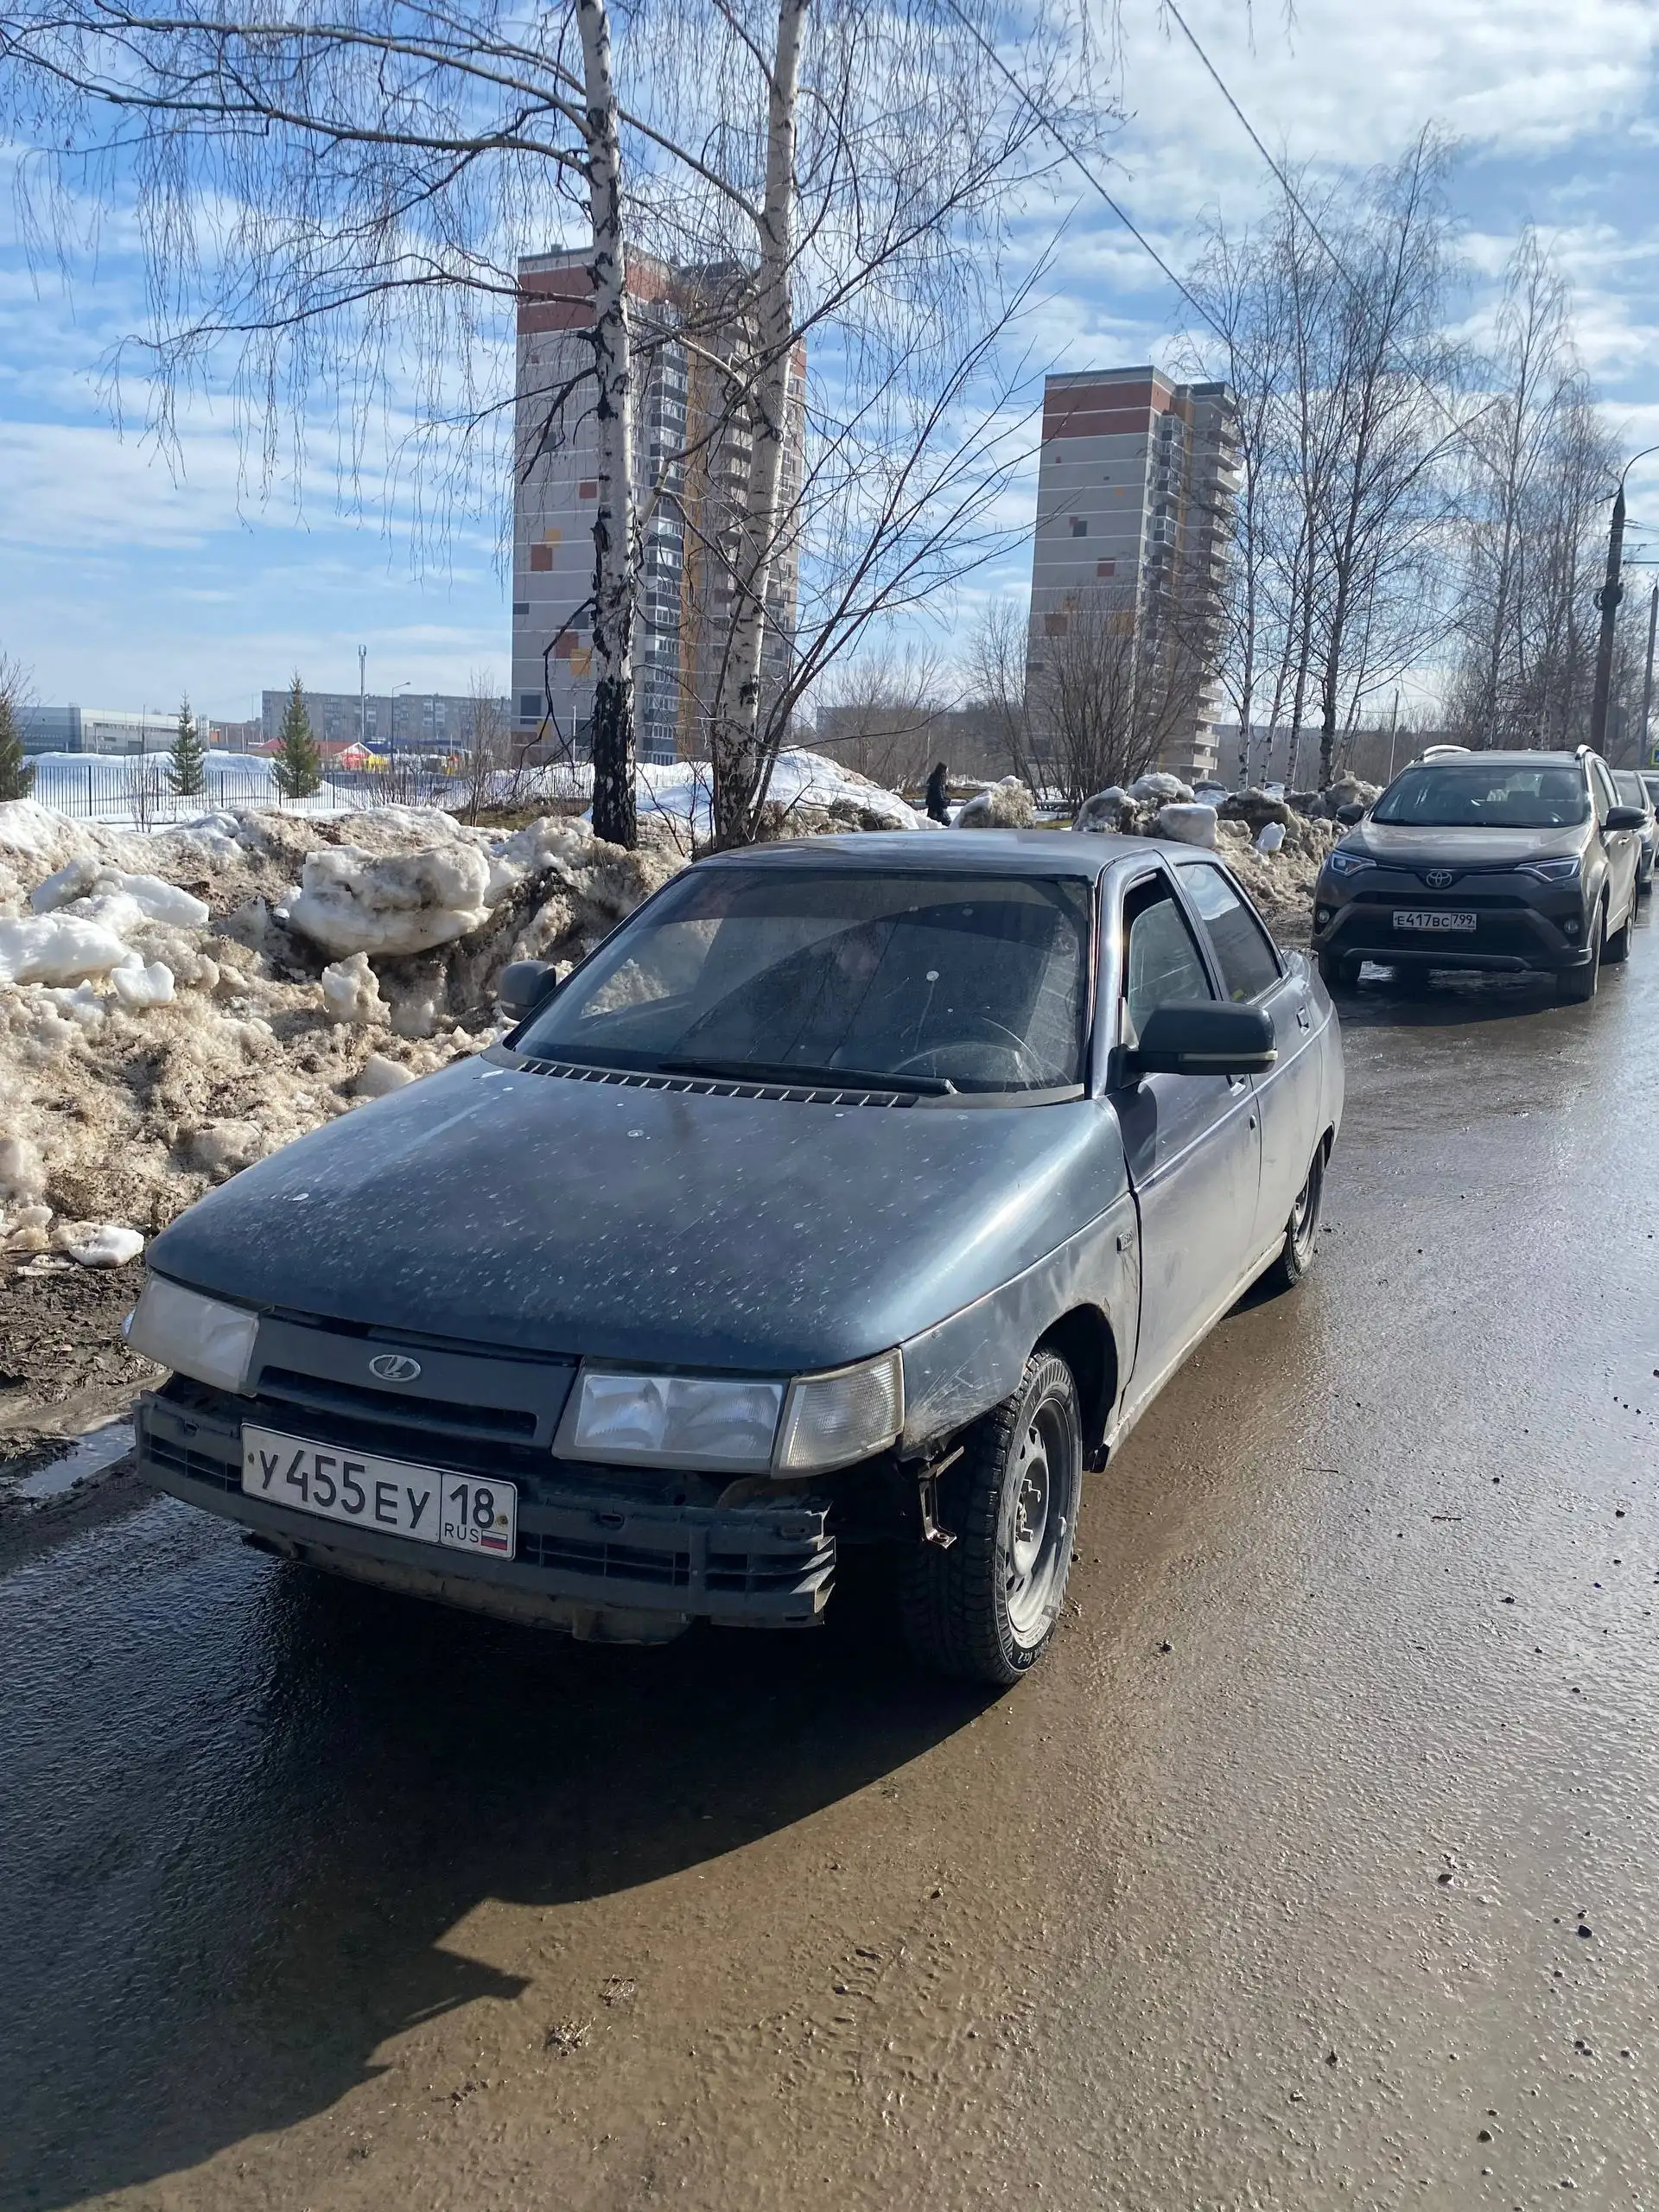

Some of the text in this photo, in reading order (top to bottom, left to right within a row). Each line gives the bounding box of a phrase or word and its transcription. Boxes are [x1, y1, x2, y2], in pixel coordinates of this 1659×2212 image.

[1397, 913, 1473, 927] Е417ВС 799
[259, 1449, 494, 1529] У455ЕУ 18
[444, 1522, 480, 1543] RUS
